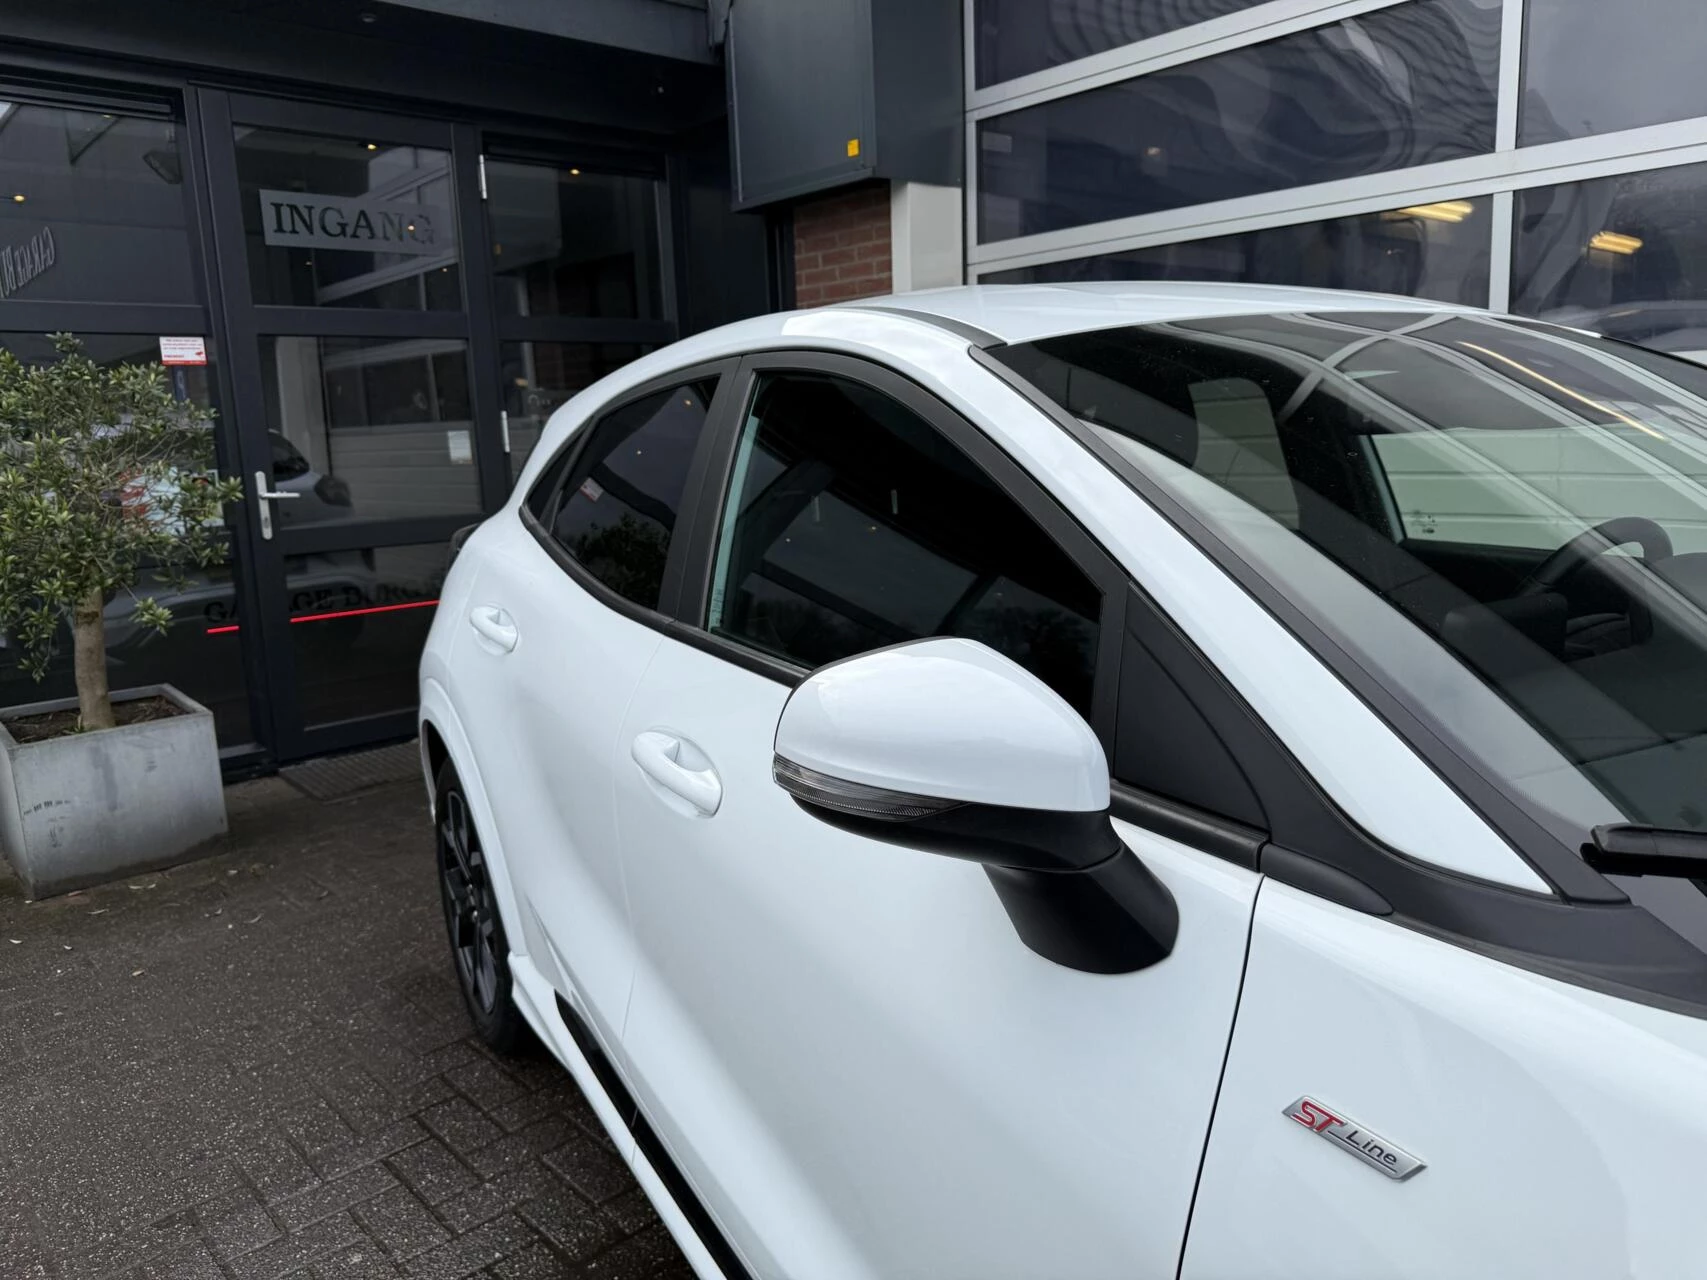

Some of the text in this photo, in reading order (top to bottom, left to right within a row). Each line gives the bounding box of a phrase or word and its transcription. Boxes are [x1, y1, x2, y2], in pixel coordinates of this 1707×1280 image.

[270, 202, 435, 245] INGANG
[1291, 1100, 1397, 1165] ST Line
